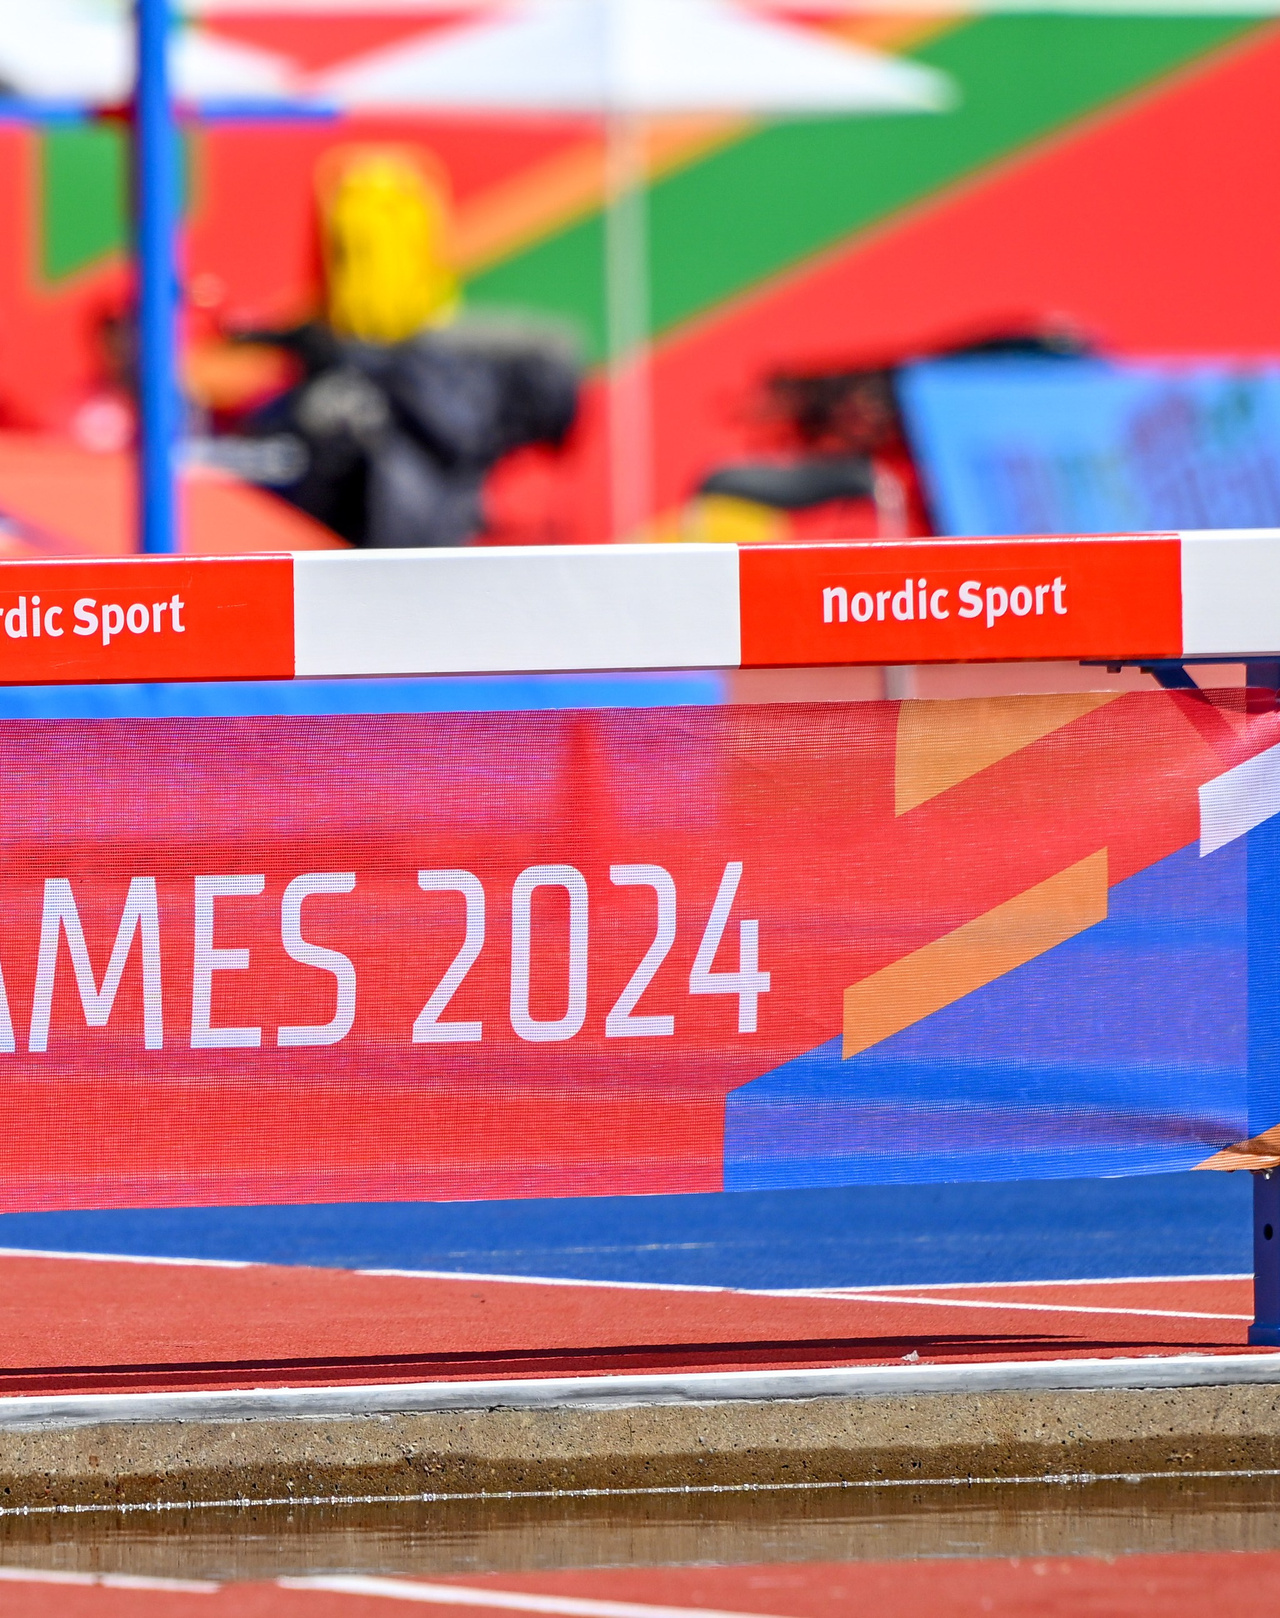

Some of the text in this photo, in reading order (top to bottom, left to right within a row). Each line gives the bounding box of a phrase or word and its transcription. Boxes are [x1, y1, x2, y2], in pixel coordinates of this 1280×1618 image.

[73, 594, 186, 647] Sport
[822, 576, 1068, 629] nordic Sport
[412, 861, 771, 1043] 2024
